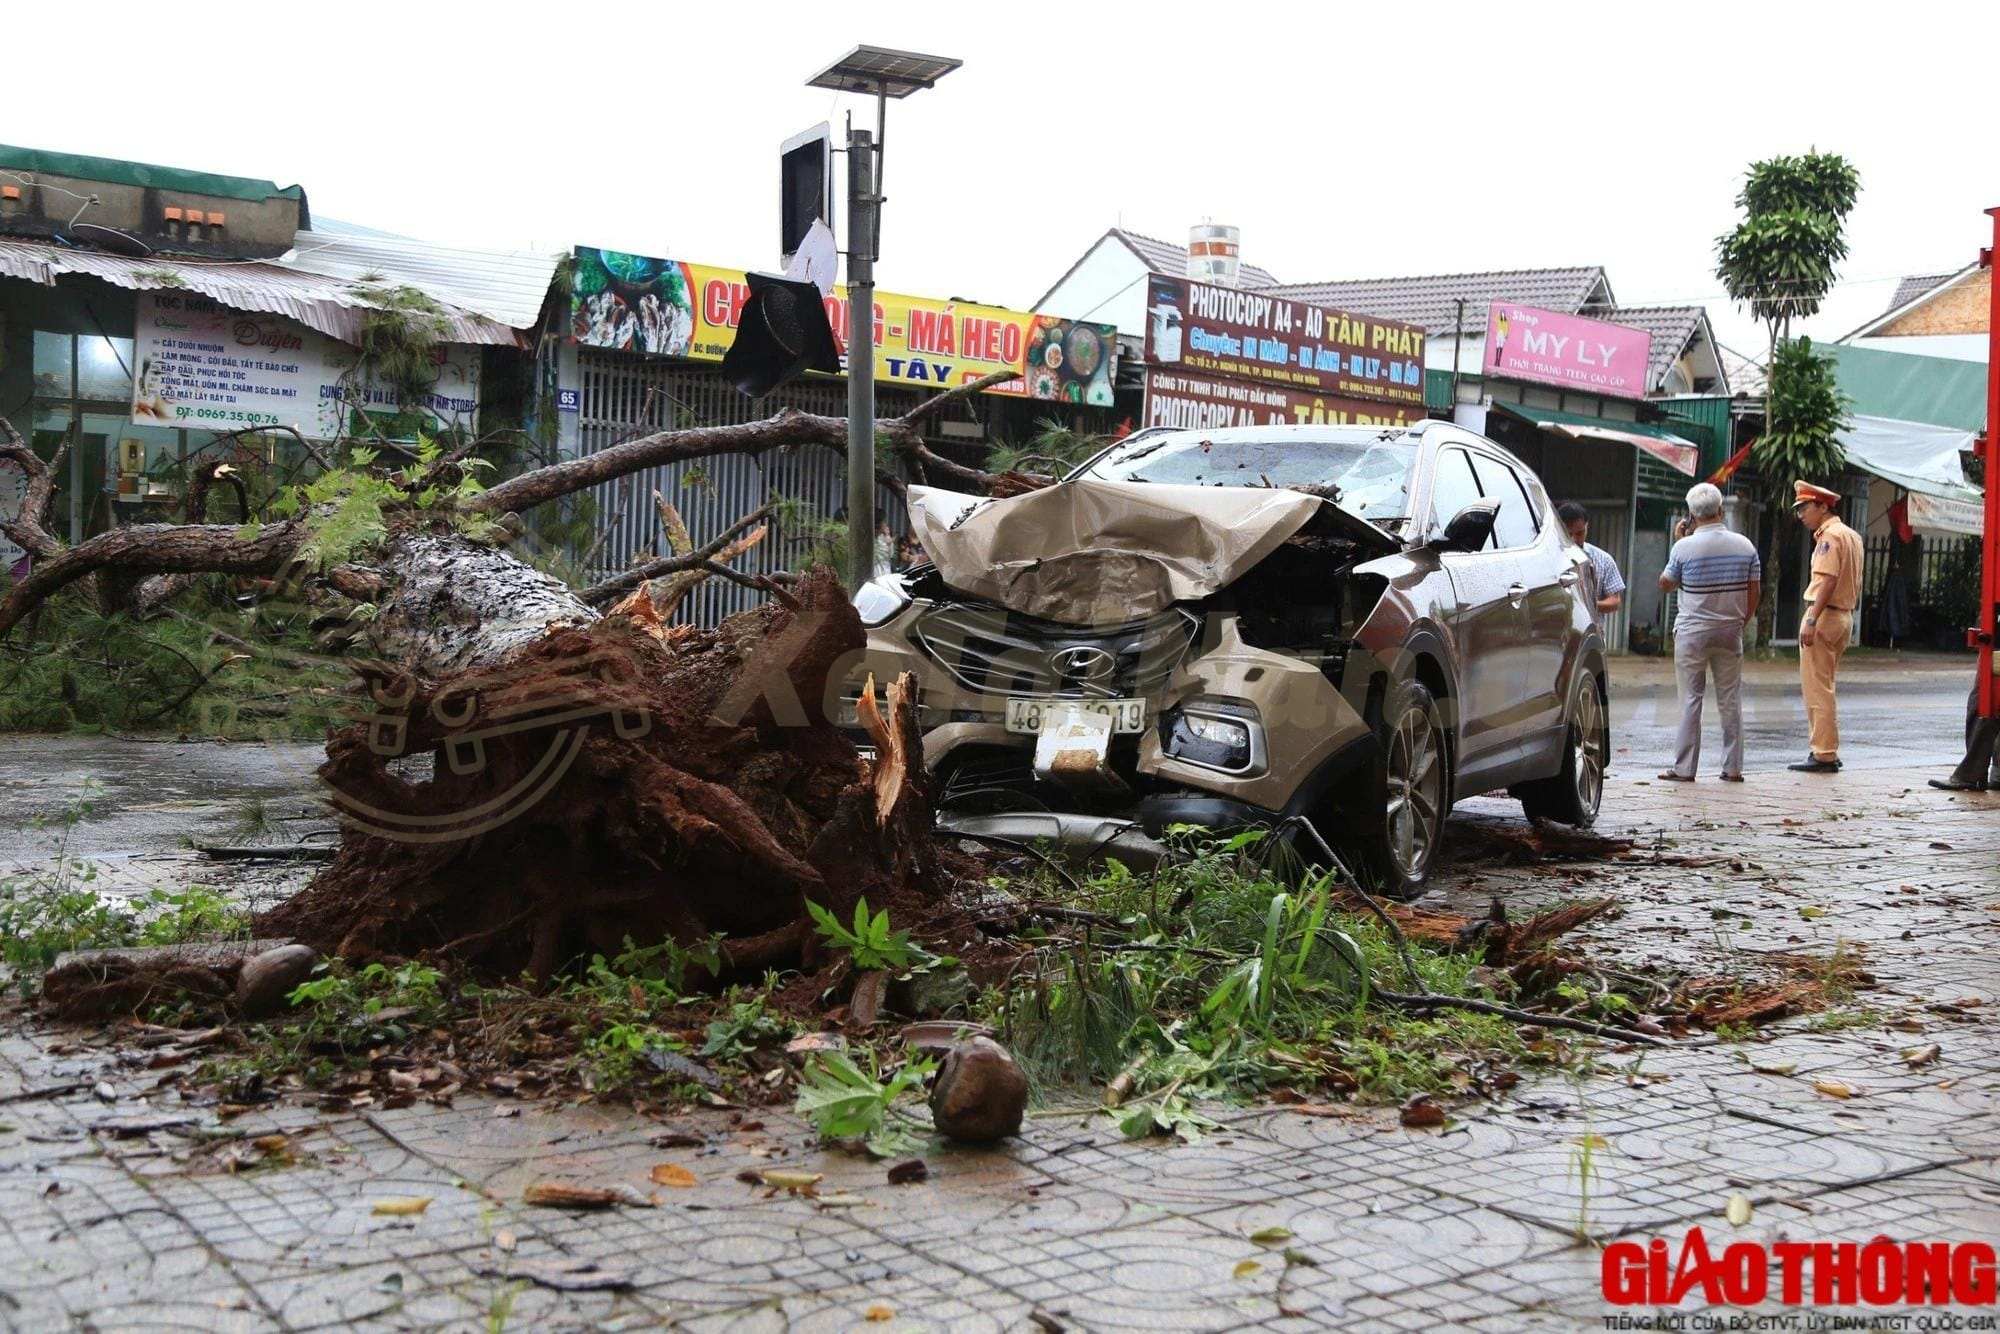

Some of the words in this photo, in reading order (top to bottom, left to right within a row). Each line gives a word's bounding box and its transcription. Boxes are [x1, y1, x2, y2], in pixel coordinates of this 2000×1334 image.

[1189, 283, 1272, 329] PHOTOCOPY
[1274, 300, 1292, 333] A4
[1326, 313, 1366, 347] TÂN
[1372, 325, 1423, 357] PHÁT
[1512, 310, 1539, 326] Shop
[909, 304, 956, 357] MÁ
[962, 316, 1021, 365] HEO
[1523, 329, 1569, 358] MY
[1577, 340, 1617, 368] LY
[1190, 326, 1241, 357] Chuyên:
[1243, 336, 1257, 359] IN
[1260, 336, 1288, 364] MÀU
[1299, 345, 1313, 368] IN
[1350, 354, 1363, 377] IN
[1365, 357, 1380, 379] LY
[1390, 361, 1402, 383] IN
[886, 358, 952, 383] TÂY
[1153, 373, 1175, 390] CÔNG
[1178, 379, 1188, 392] TY
[1189, 380, 1211, 395] TNHH
[561, 392, 575, 404] 65
[1151, 394, 1235, 429] PHOTOCOPY
[197, 408, 279, 424] 0969.35.00.76
